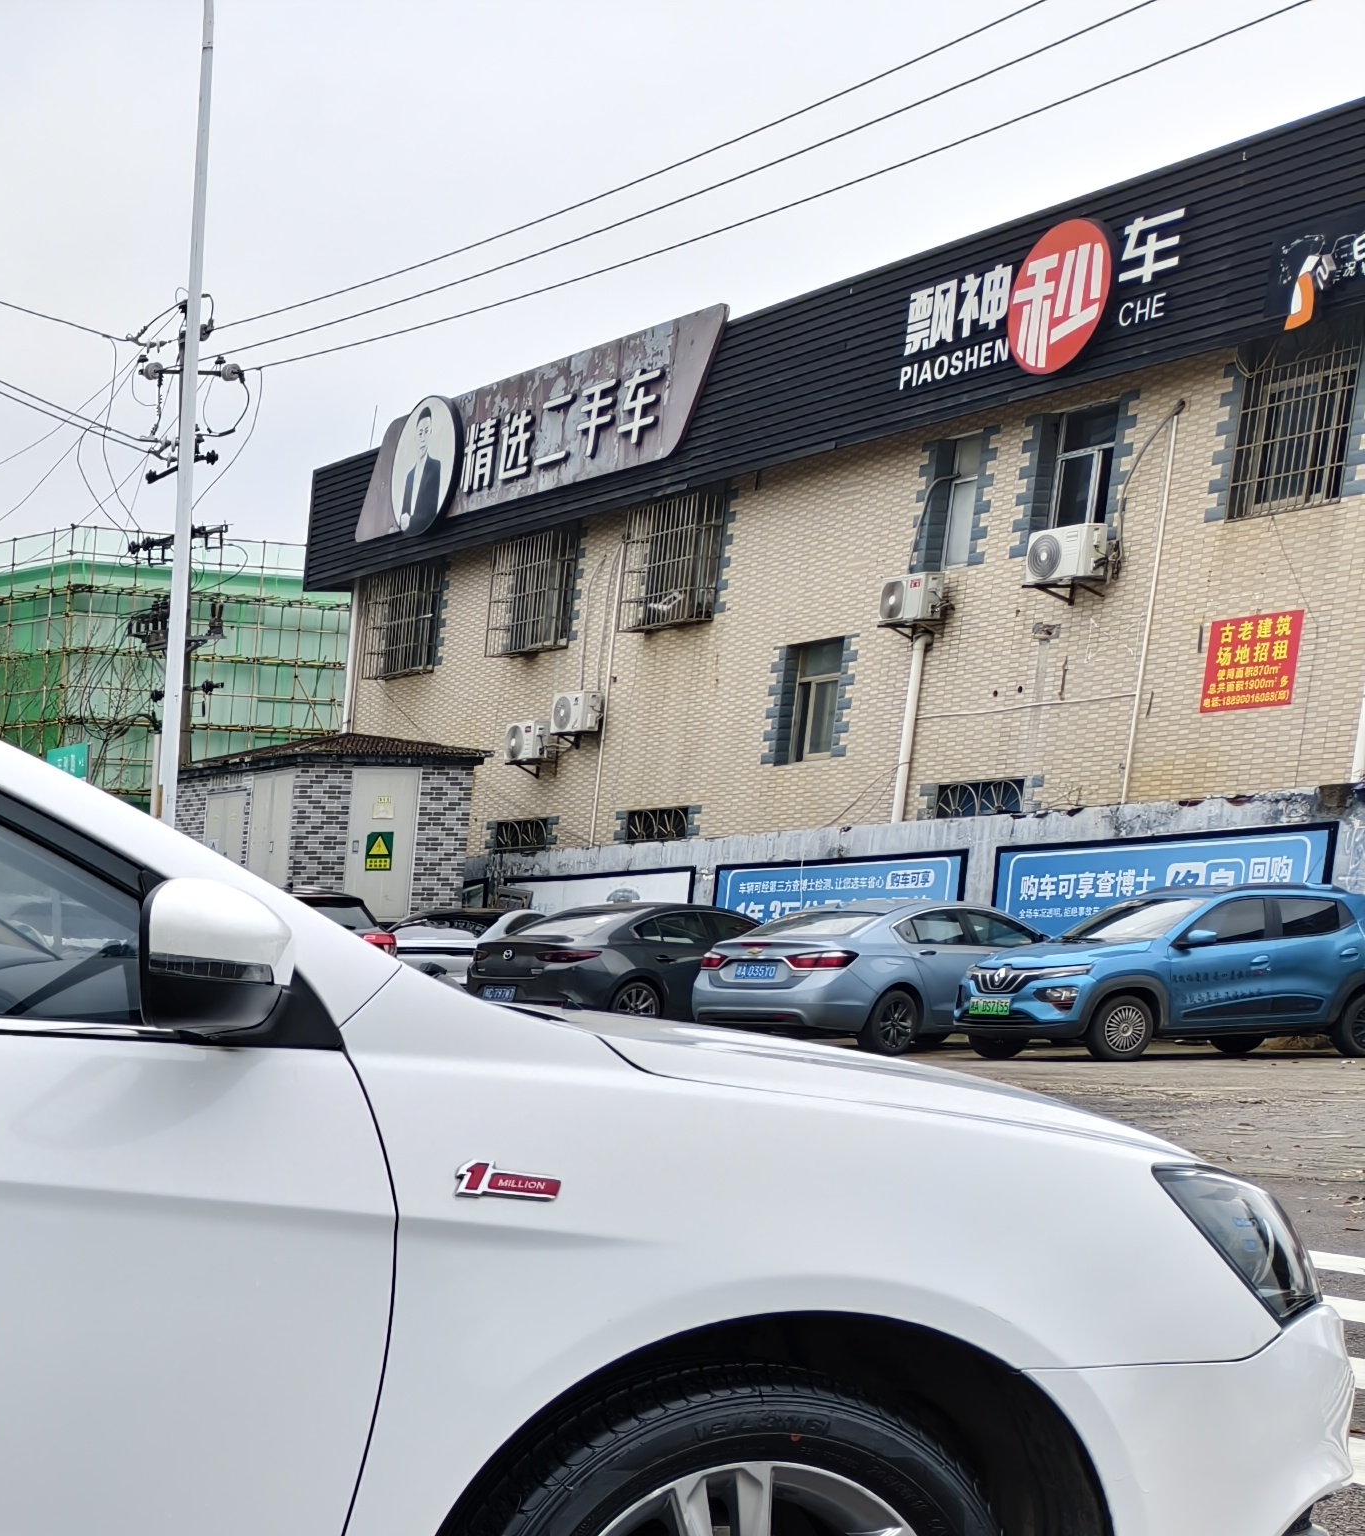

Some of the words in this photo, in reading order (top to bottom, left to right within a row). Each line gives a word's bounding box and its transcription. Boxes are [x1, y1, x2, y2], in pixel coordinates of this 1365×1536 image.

[898, 337, 1009, 390] PIAOSHEN
[1118, 292, 1168, 327] CHE
[459, 367, 663, 494] 精选二手车
[1220, 614, 1292, 643] 古老建筑
[1216, 640, 1288, 666] 场地招租
[1019, 869, 1156, 900] 购车可享查博士
[456, 1159, 491, 1196] 1
[497, 1178, 546, 1190] MILLION
